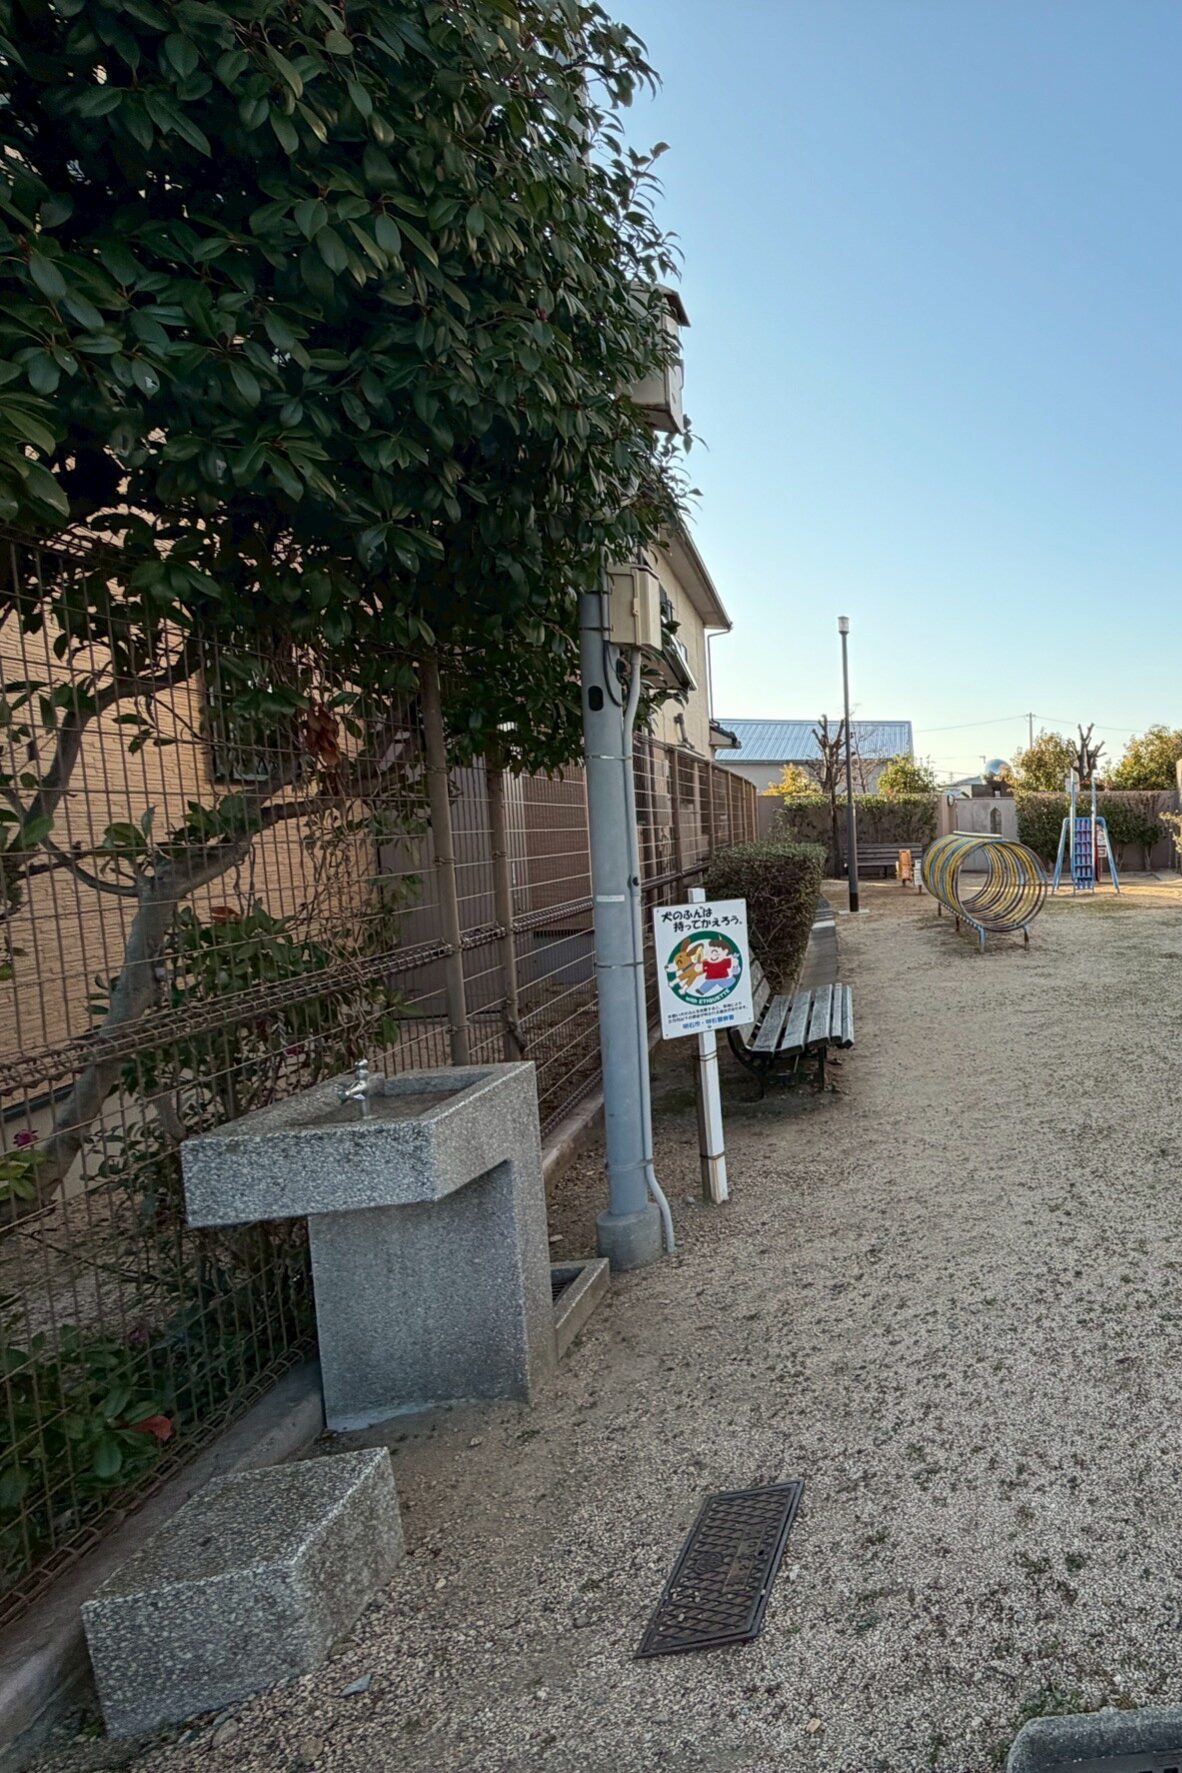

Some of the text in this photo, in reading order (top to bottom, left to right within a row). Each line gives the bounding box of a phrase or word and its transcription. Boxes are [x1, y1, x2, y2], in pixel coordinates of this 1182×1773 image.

[661, 907, 713, 923] 犬のふんは
[673, 915, 743, 933] 持ってかえろう。
